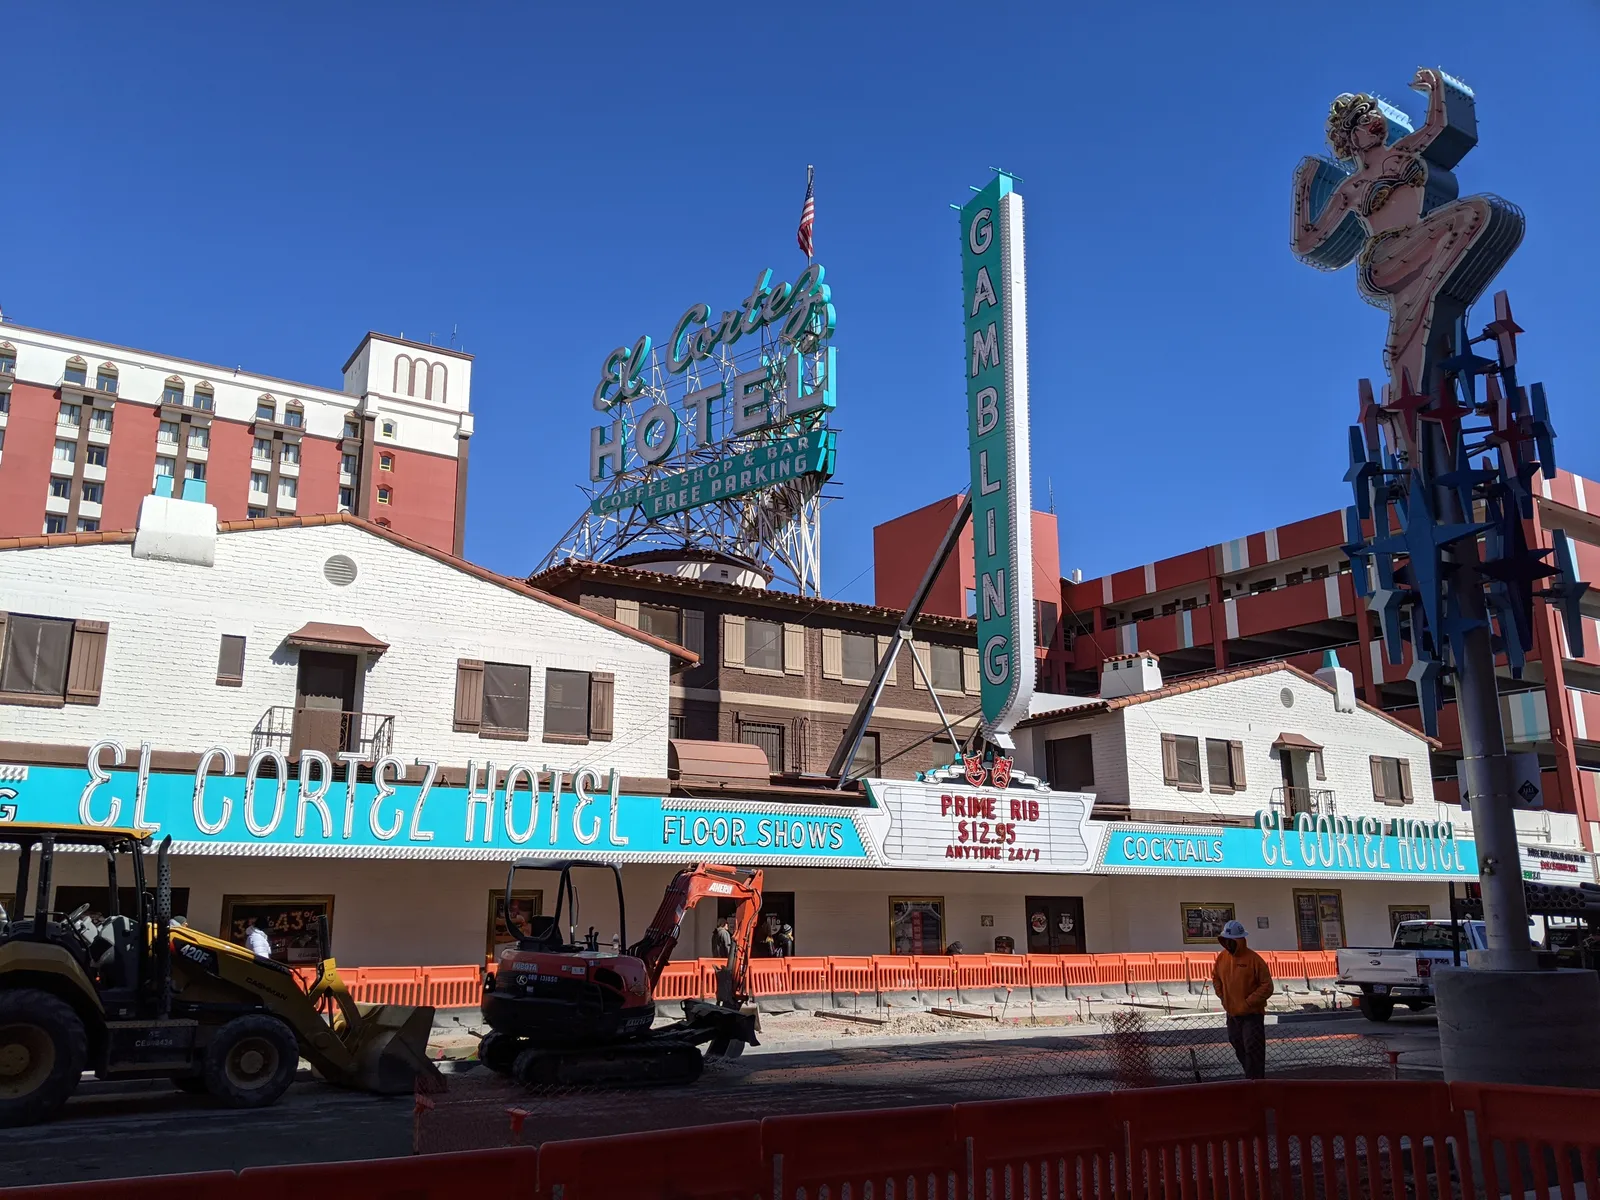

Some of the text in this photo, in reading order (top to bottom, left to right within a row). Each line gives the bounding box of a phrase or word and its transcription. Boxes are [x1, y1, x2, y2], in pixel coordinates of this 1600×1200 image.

[593, 263, 836, 412] El Cortez
[590, 350, 829, 482] HOTEL
[968, 206, 1010, 686] GAMBLING
[599, 436, 810, 512] COFFEE SHOP & BAR
[653, 453, 807, 514] FREE PARKING
[79, 739, 629, 846] EL CORTEZ HOTEL
[940, 794, 1040, 821] PRIME RIB
[663, 815, 844, 850] FLOOR SHOWS
[945, 845, 1040, 862] ANYTIME 24/7
[957, 820, 1017, 845] $12.95
[1122, 836, 1224, 863] COCKTAILS
[1257, 809, 1466, 872] EL CORTEZ HOTEL
[180, 943, 210, 964] 420F
